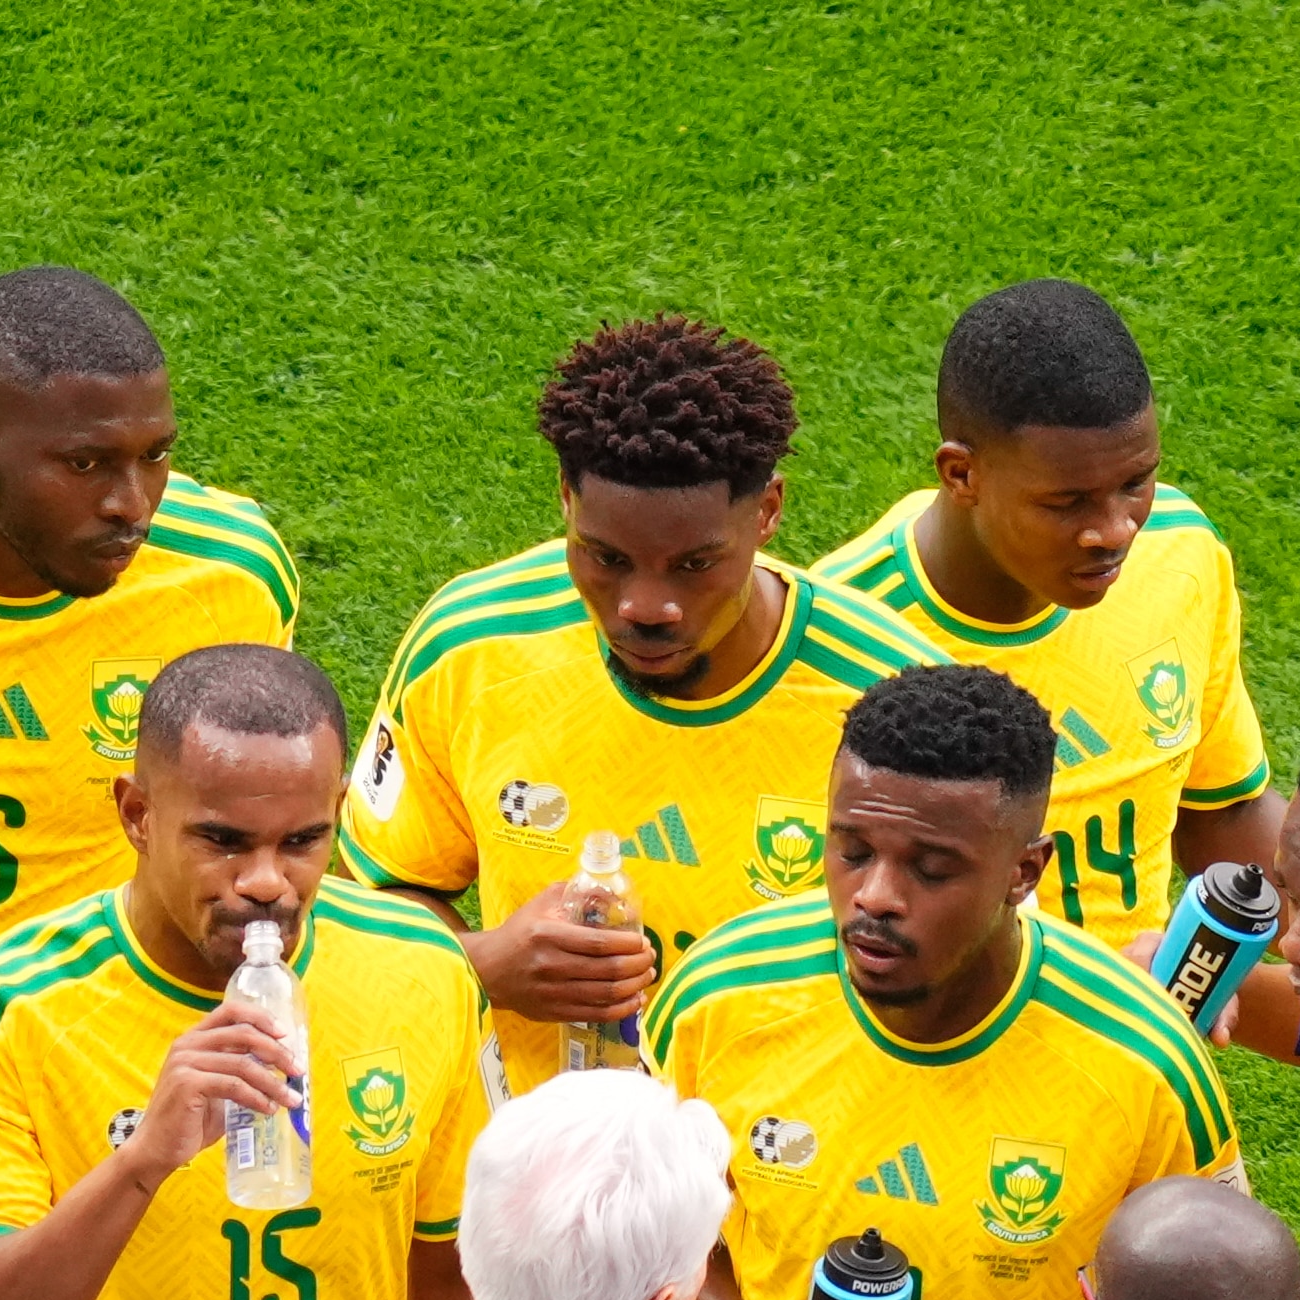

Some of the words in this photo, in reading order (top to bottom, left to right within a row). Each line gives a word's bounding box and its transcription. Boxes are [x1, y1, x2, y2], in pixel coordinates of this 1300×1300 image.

[1050, 798, 1138, 927] 14
[359, 1142, 385, 1155] SOUTH
[987, 1222, 1017, 1242] SOUTH
[1016, 1230, 1049, 1242] AFRICA
